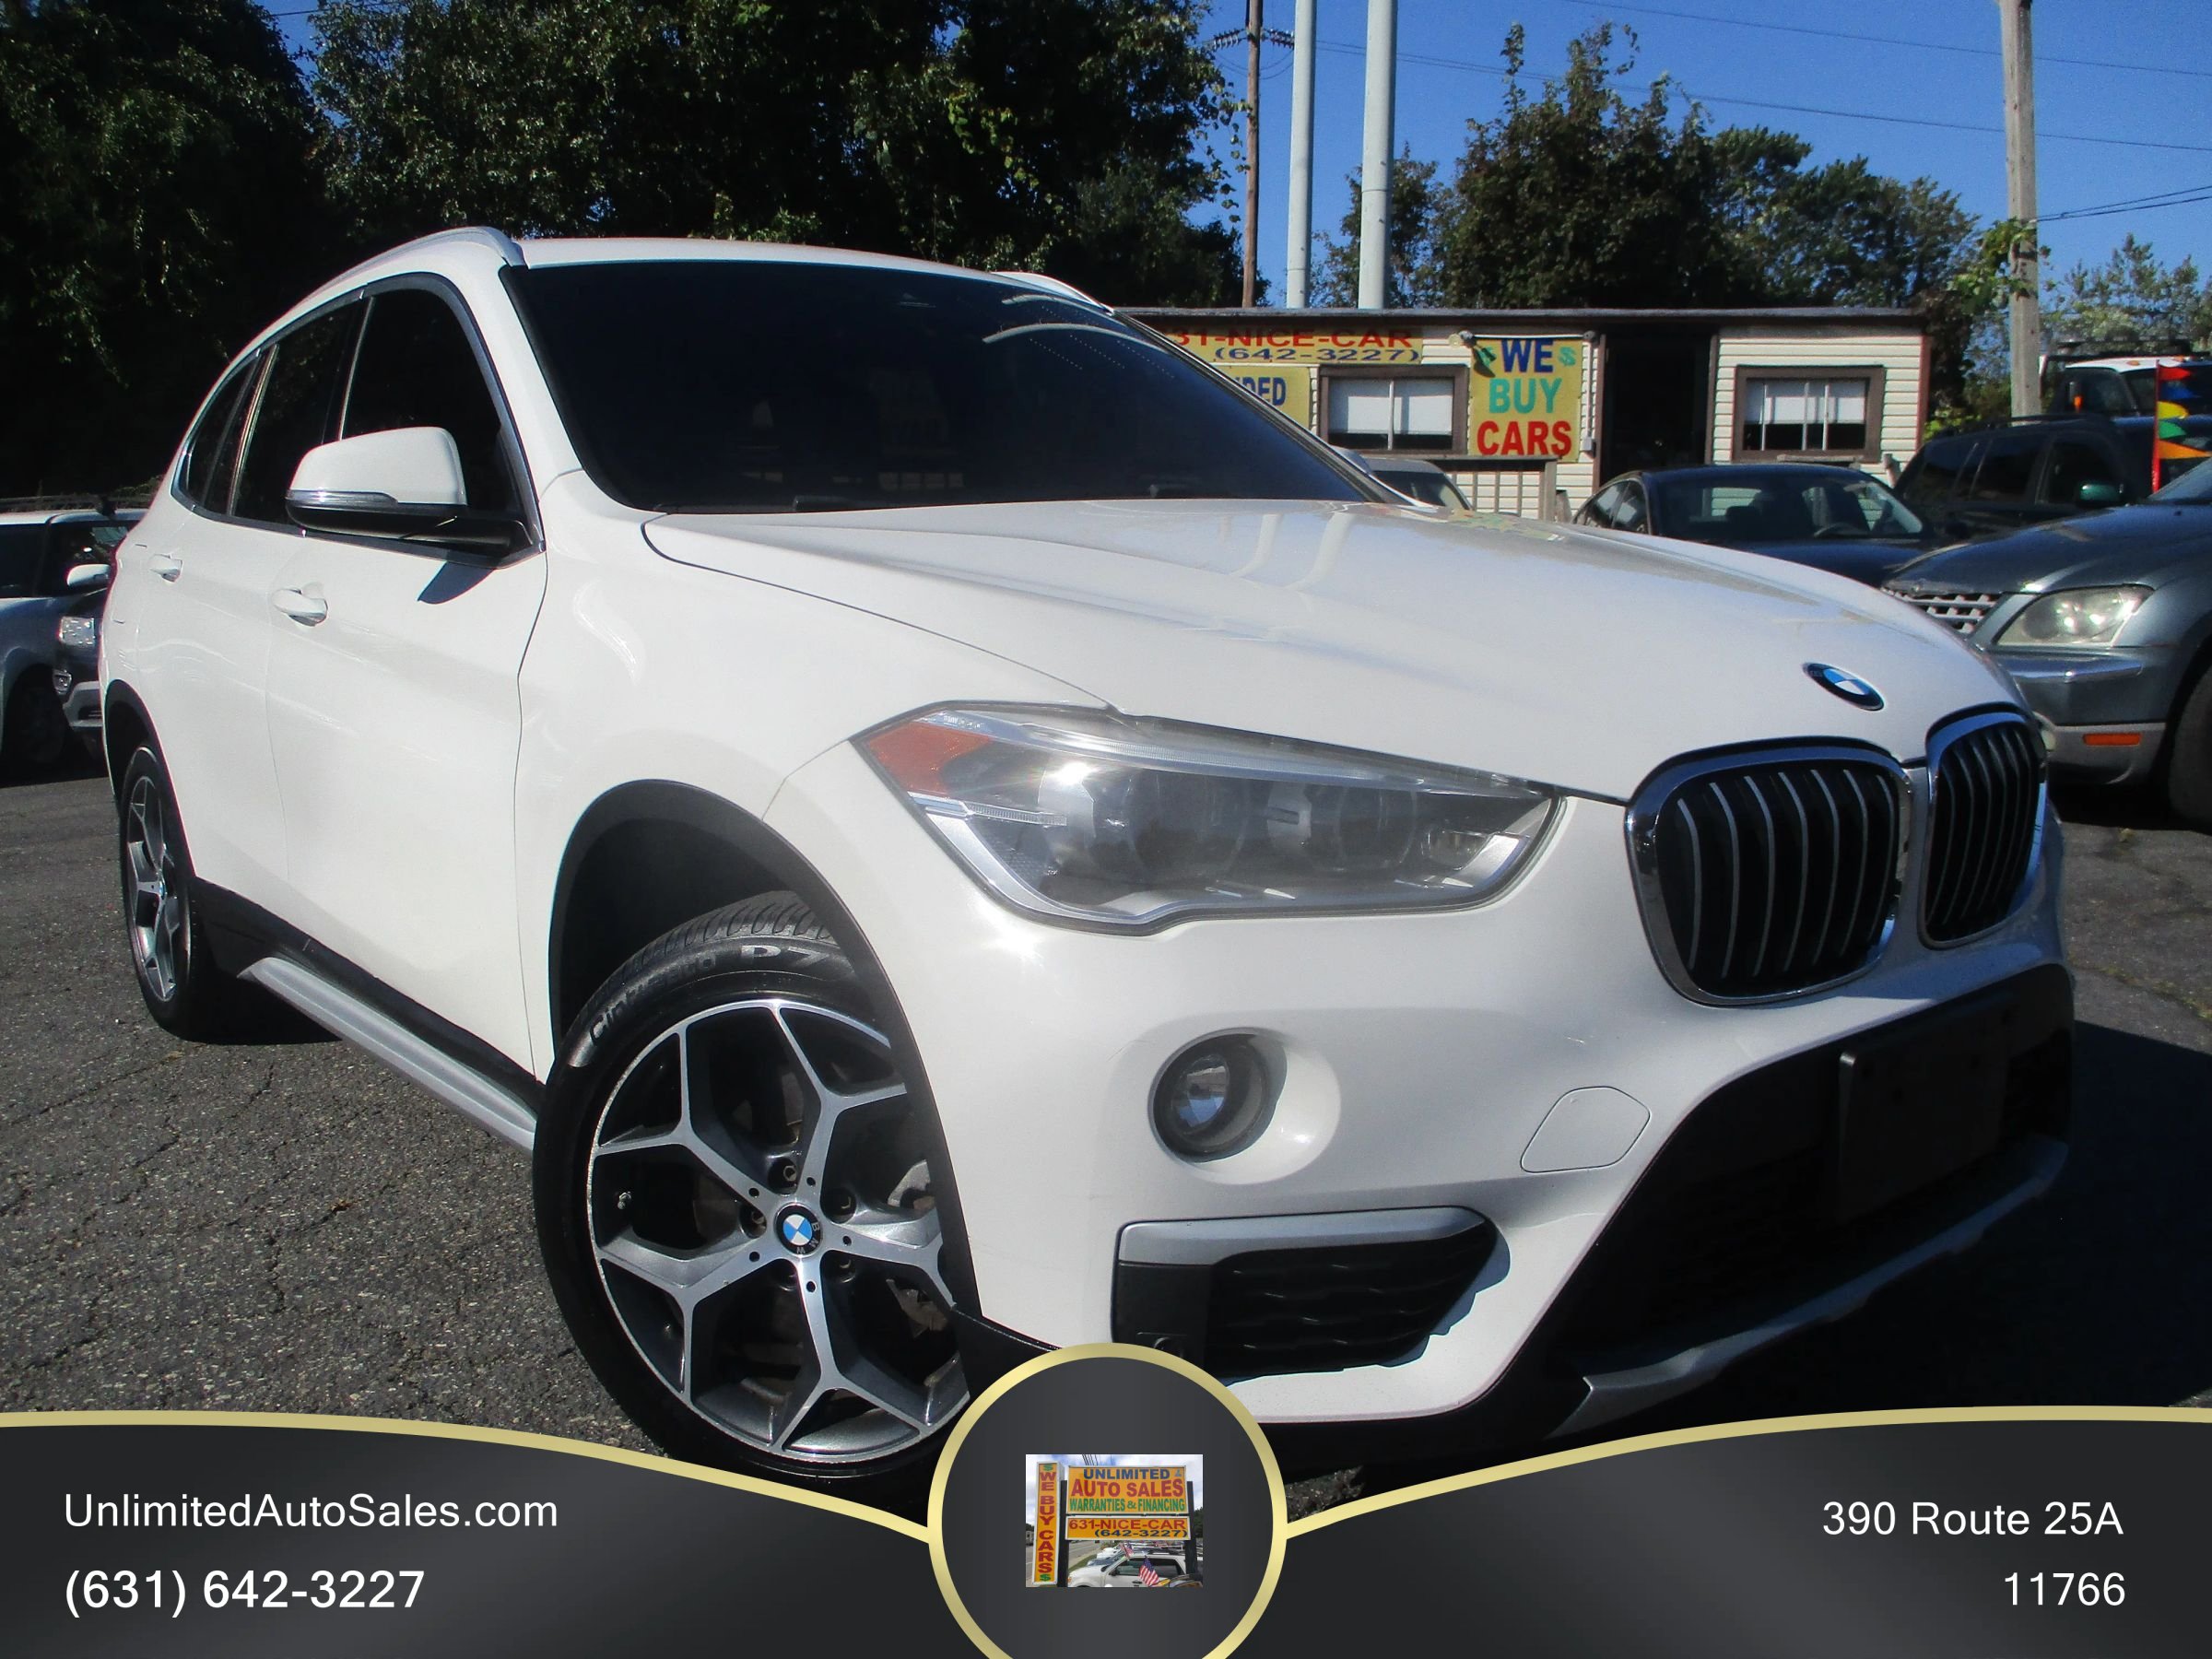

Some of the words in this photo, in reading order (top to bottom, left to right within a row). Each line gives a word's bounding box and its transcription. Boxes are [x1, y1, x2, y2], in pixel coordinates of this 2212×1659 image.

[1216, 347, 1419, 361] (642-3227)
[1500, 338, 1554, 373] WE
[1488, 378, 1562, 414] BUY
[1477, 420, 1572, 457] CARS
